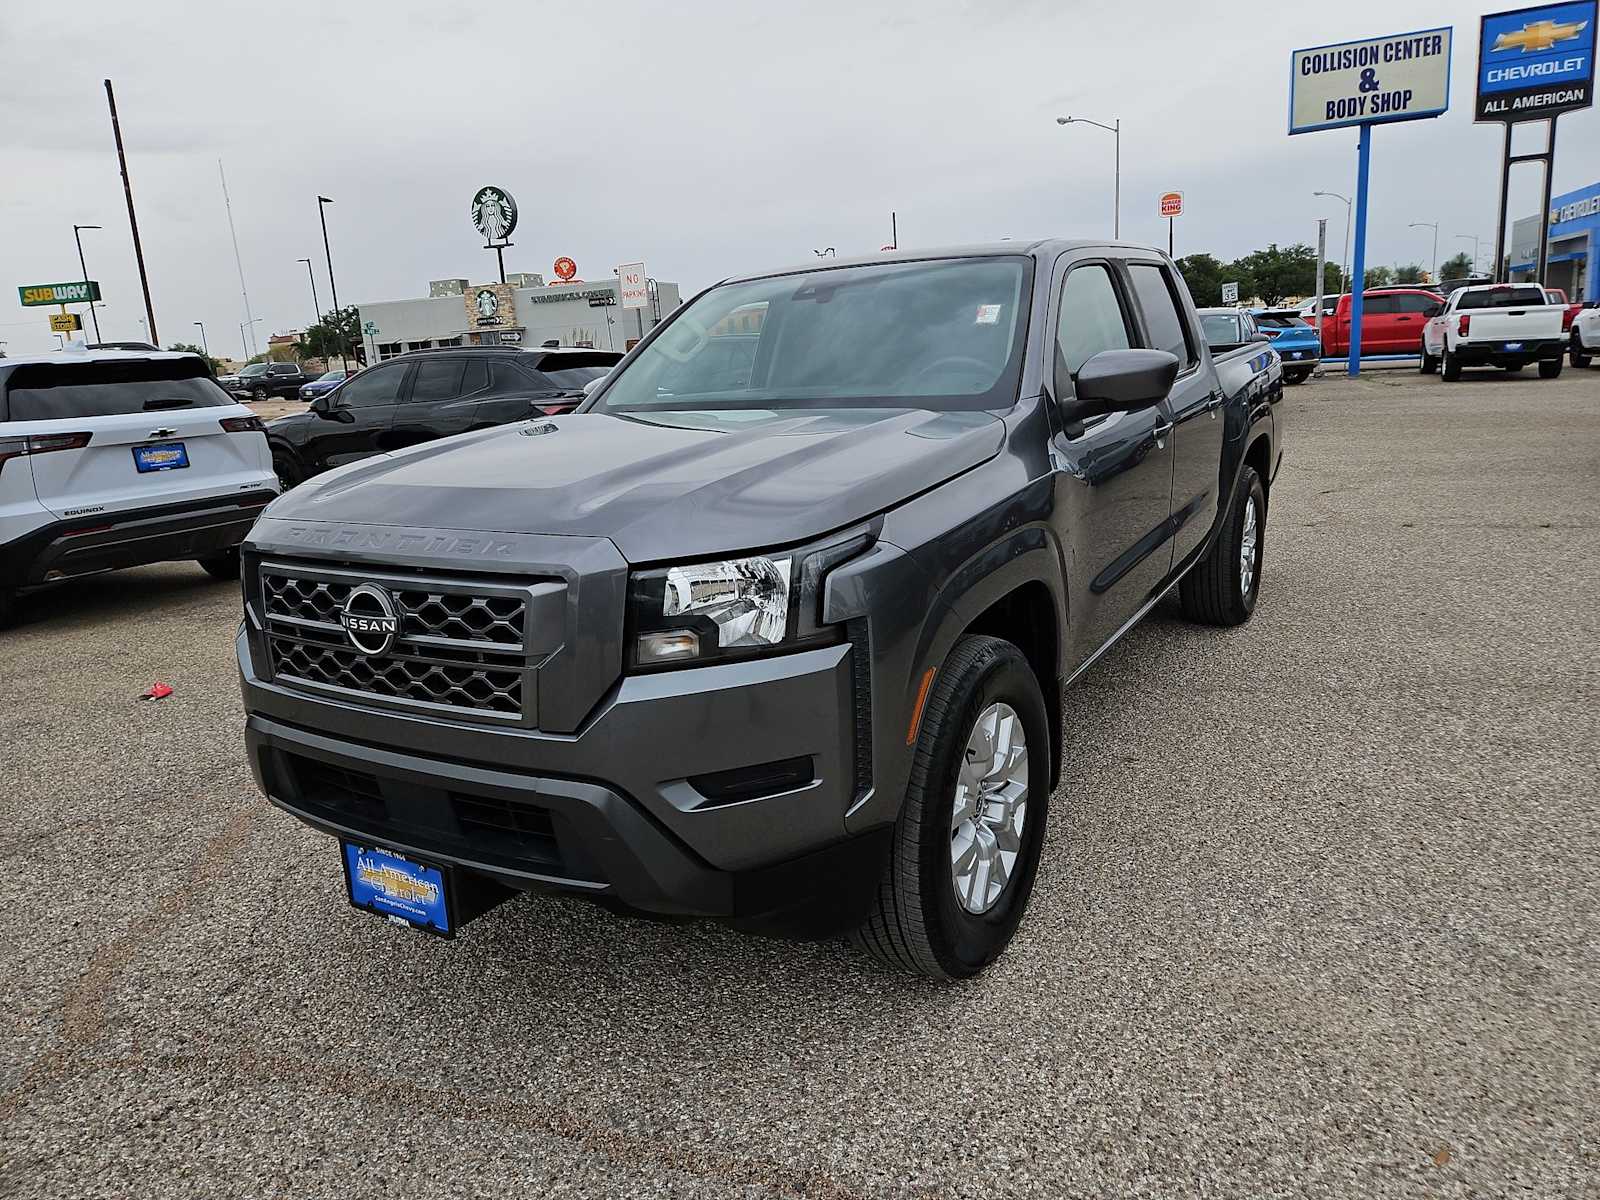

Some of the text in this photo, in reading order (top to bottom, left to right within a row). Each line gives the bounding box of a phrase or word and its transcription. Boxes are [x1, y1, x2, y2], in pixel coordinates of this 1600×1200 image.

[1301, 35, 1442, 76] COLLISION CENTER
[1359, 67, 1380, 93] &
[1487, 57, 1585, 83] CHEVROLET
[1326, 89, 1412, 120] BODY SHOP
[1484, 88, 1585, 113] ALL AMERICAN
[626, 273, 639, 284] NO
[23, 284, 88, 304] SUBWAY
[623, 288, 646, 298] PARKING
[64, 505, 105, 516] EQUINOX
[287, 527, 520, 556] FRONTIER
[341, 615, 396, 632] NISSAN
[375, 846, 393, 857] SINCE
[356, 856, 440, 894] All American
